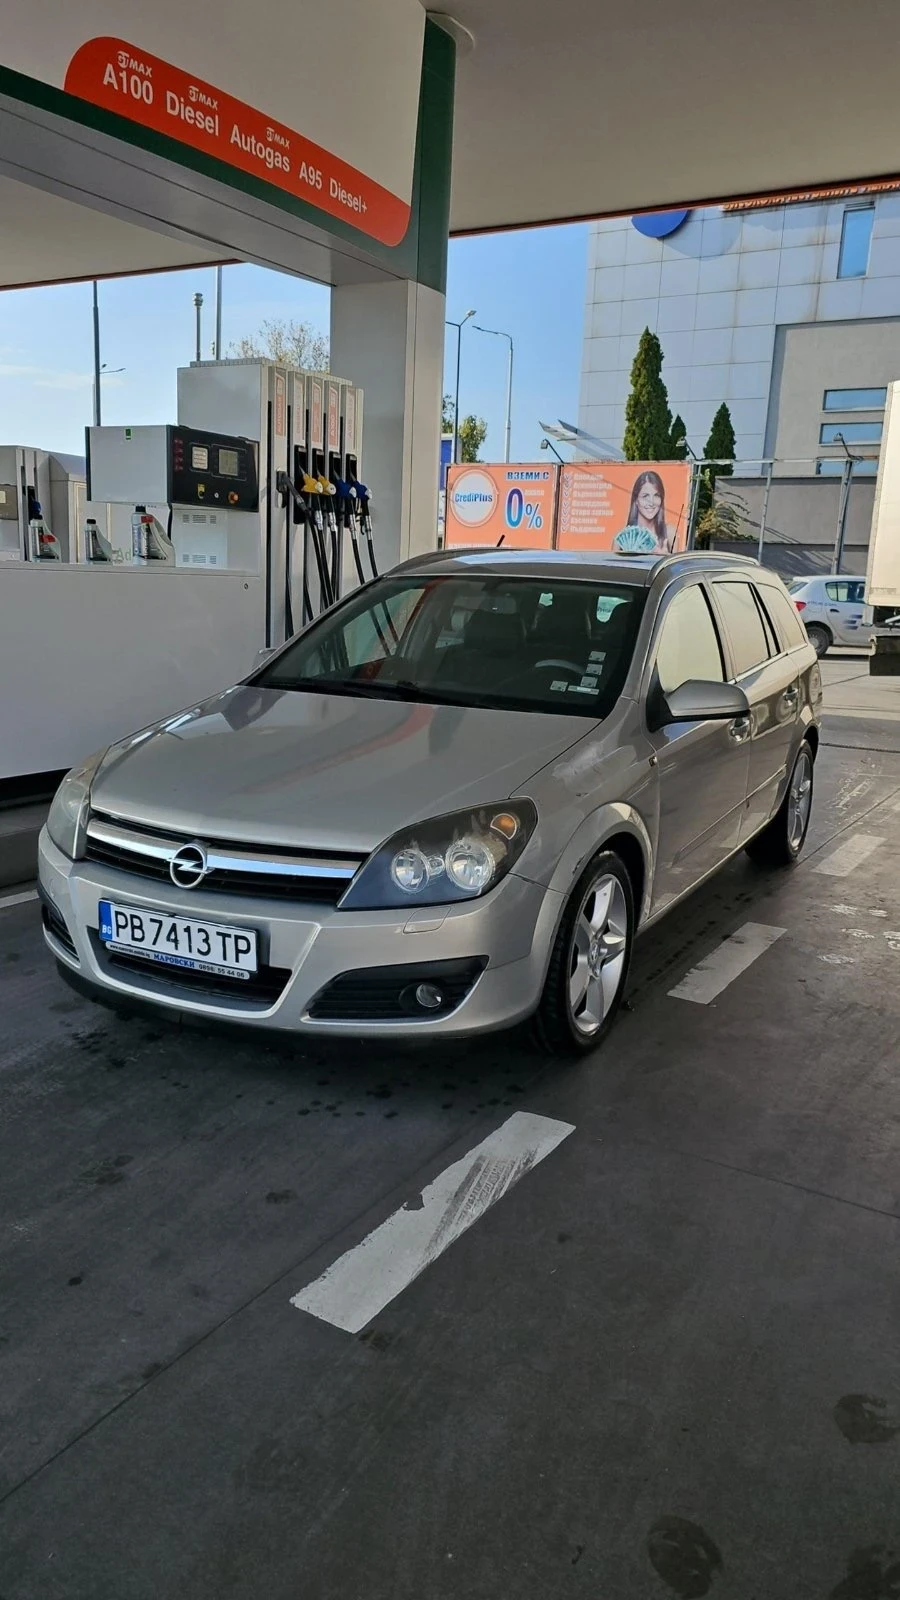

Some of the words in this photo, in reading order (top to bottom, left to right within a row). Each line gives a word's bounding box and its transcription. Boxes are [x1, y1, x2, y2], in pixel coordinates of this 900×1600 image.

[103, 63, 153, 105] A100
[166, 90, 219, 136] Diesel
[230, 124, 290, 172] Autogas
[299, 162, 323, 190] A95
[329, 177, 368, 213] Diesel+
[507, 471, 540, 480] ВЗЕМИ
[454, 492, 493, 502] CrediPlus
[506, 487, 543, 529] 0%
[102, 924, 112, 935] BG
[153, 954, 195, 968] МАРОВСКИ
